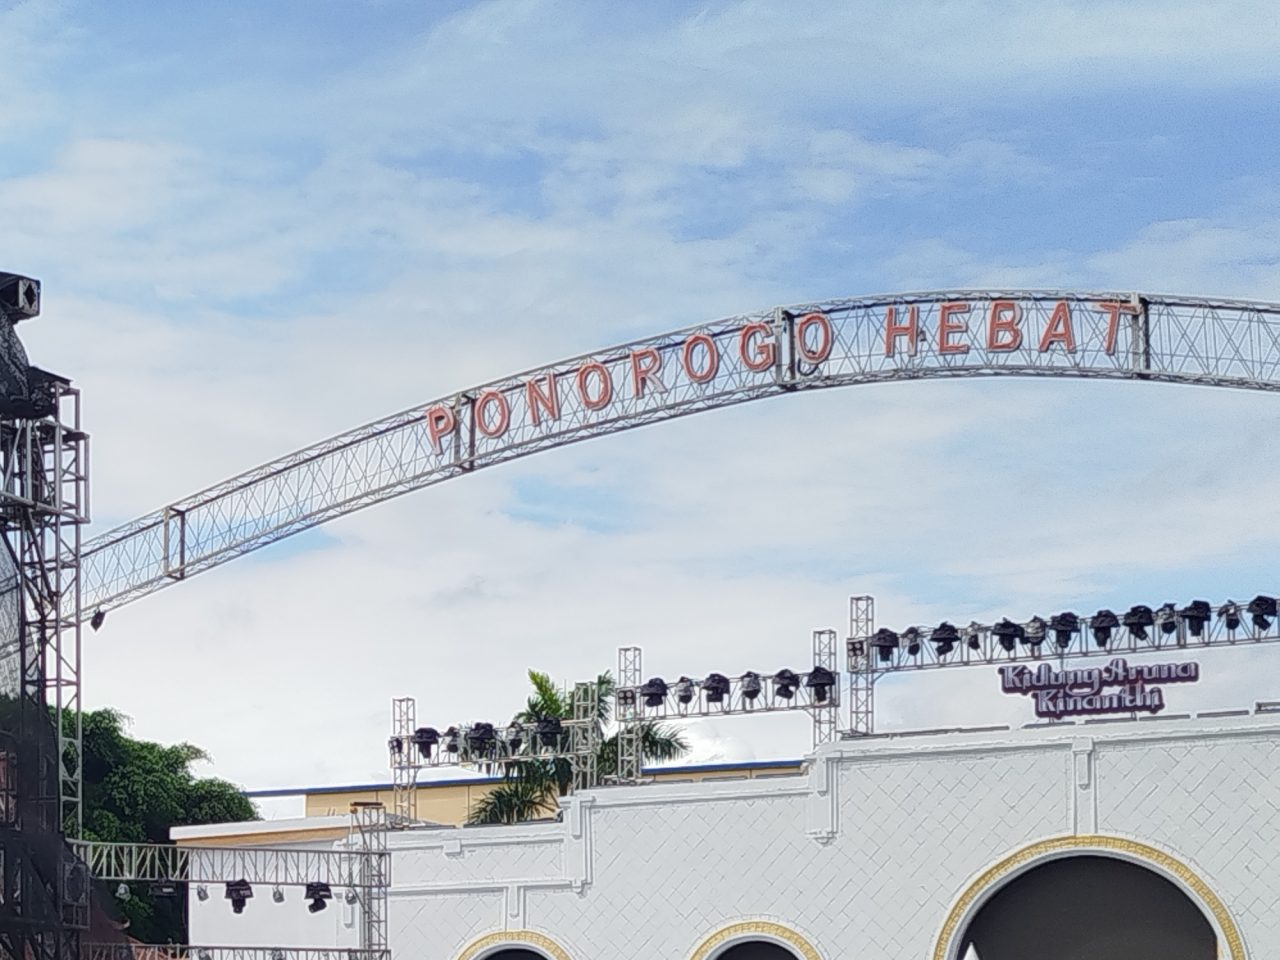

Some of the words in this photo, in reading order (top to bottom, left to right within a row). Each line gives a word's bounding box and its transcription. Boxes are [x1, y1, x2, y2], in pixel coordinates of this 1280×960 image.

[426, 313, 833, 456] PONOROGO
[884, 298, 1139, 358] HEBAT
[1000, 664, 1101, 696] Kidung
[1102, 659, 1197, 683] Aruna
[1032, 683, 1162, 714] Kinanthi
